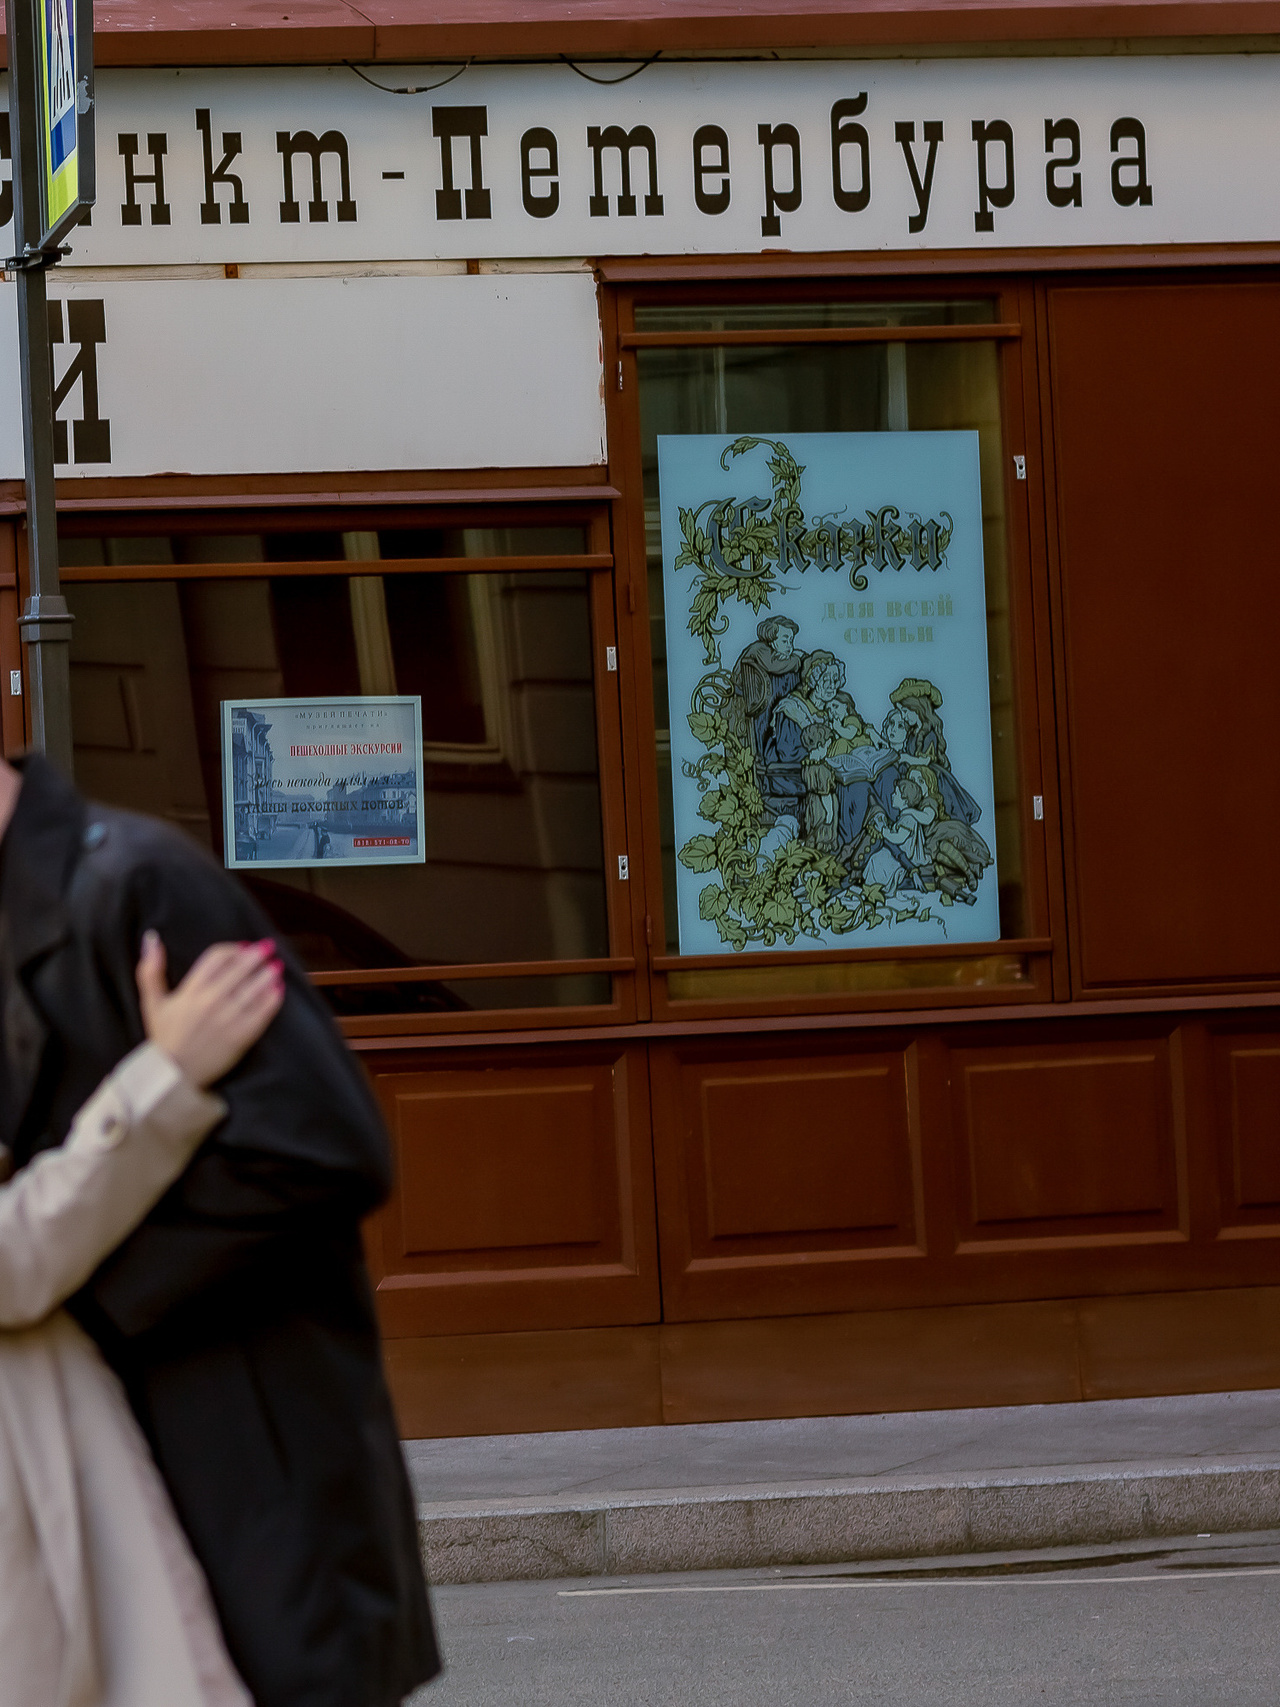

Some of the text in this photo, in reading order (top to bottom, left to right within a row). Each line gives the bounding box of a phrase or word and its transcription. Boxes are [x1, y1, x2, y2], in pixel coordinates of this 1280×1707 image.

[706, 495, 946, 591] Сказки
[821, 593, 953, 622] ДЛЯ ВСЕЙ
[843, 626, 934, 644] СЕМЬИ
[290, 742, 403, 757] ПЕШЕХОДНЫЕ ЭКСКУРСИИ
[286, 771, 331, 788] некогда
